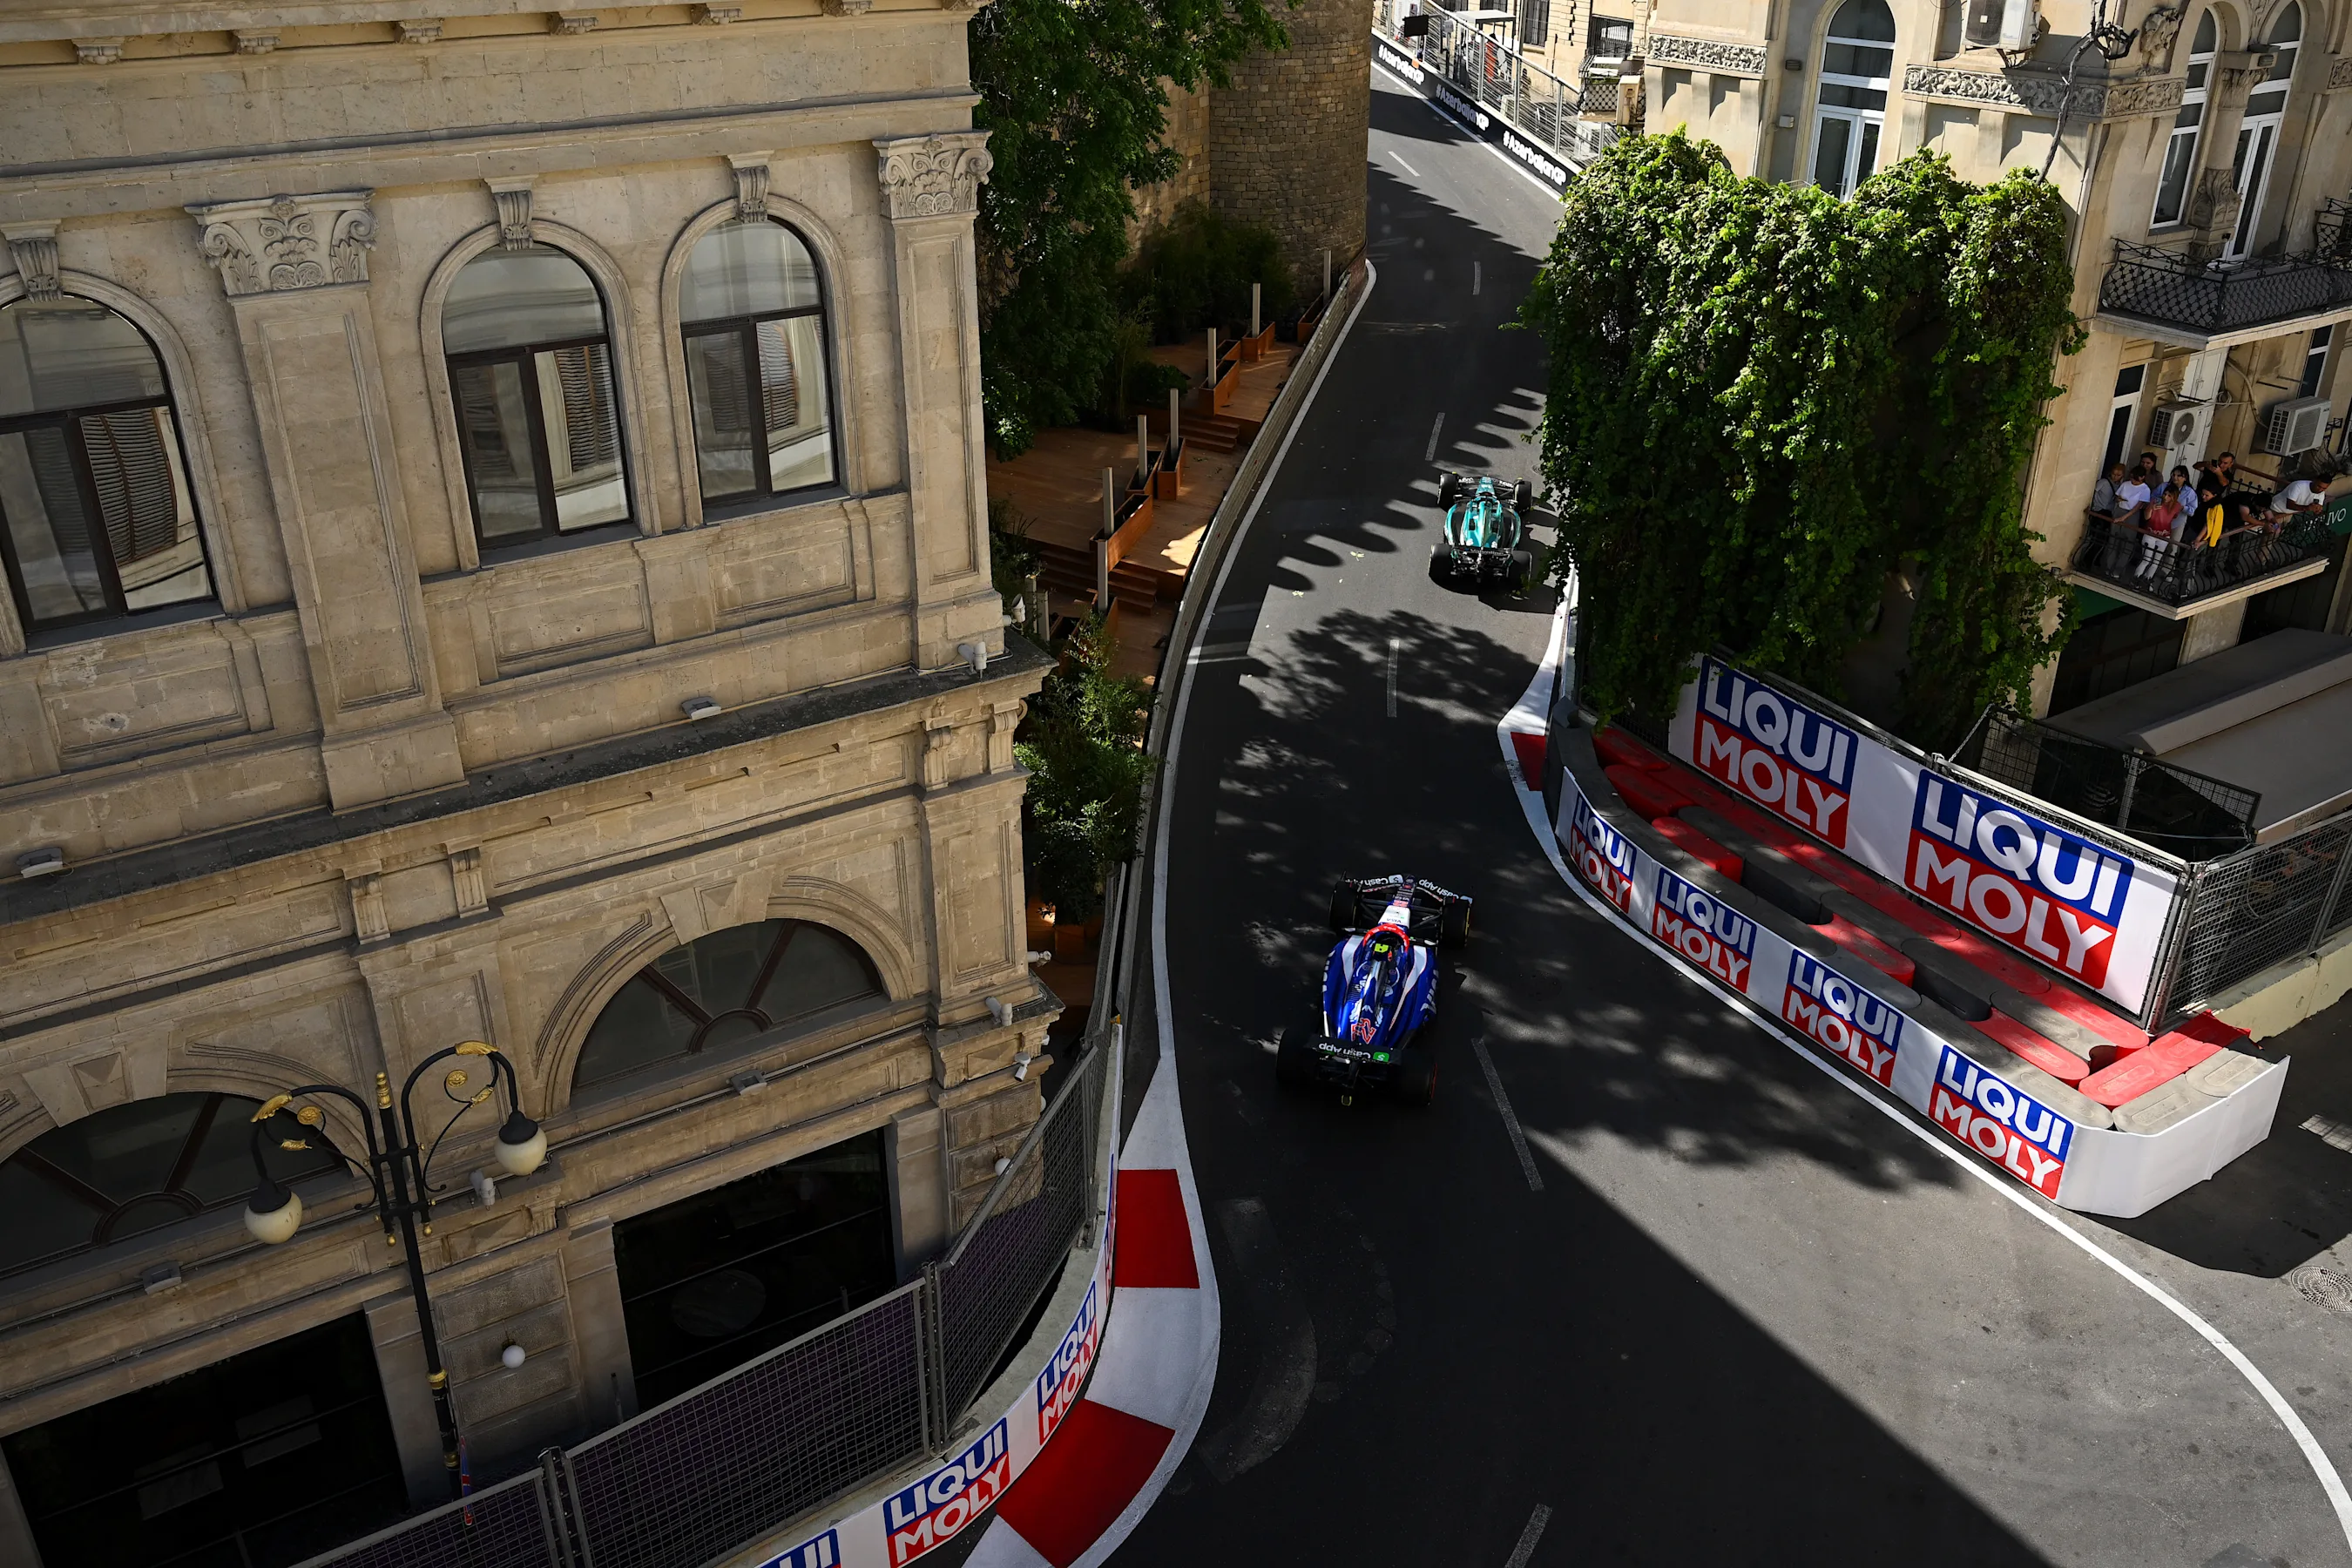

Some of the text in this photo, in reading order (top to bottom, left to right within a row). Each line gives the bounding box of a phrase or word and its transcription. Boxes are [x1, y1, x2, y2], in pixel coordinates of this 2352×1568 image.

[1503, 131, 1567, 186] #AzerbaijanGP
[1705, 662, 1849, 785] LIQUI
[1700, 720, 1847, 836] MOLY
[1571, 828, 1631, 905] MOLY
[1574, 796, 1633, 876] LIQUI
[1923, 779, 2122, 916] LIQUI
[1656, 908, 1749, 985] MOLY
[1659, 873, 1753, 954] LIQUI
[1914, 839, 2112, 974] MOLY
[1318, 1043, 1342, 1053] App
[1787, 990, 1894, 1078] MOLY
[1793, 955, 1898, 1046] LIQUI
[1934, 1089, 2062, 1188] MOLY
[1941, 1050, 2066, 1156] LIQUI
[1040, 1289, 1095, 1405] LIQUI
[1042, 1322, 1097, 1438] MOLY
[890, 1424, 1004, 1531] LIQUI
[894, 1454, 1008, 1565] MOLY
